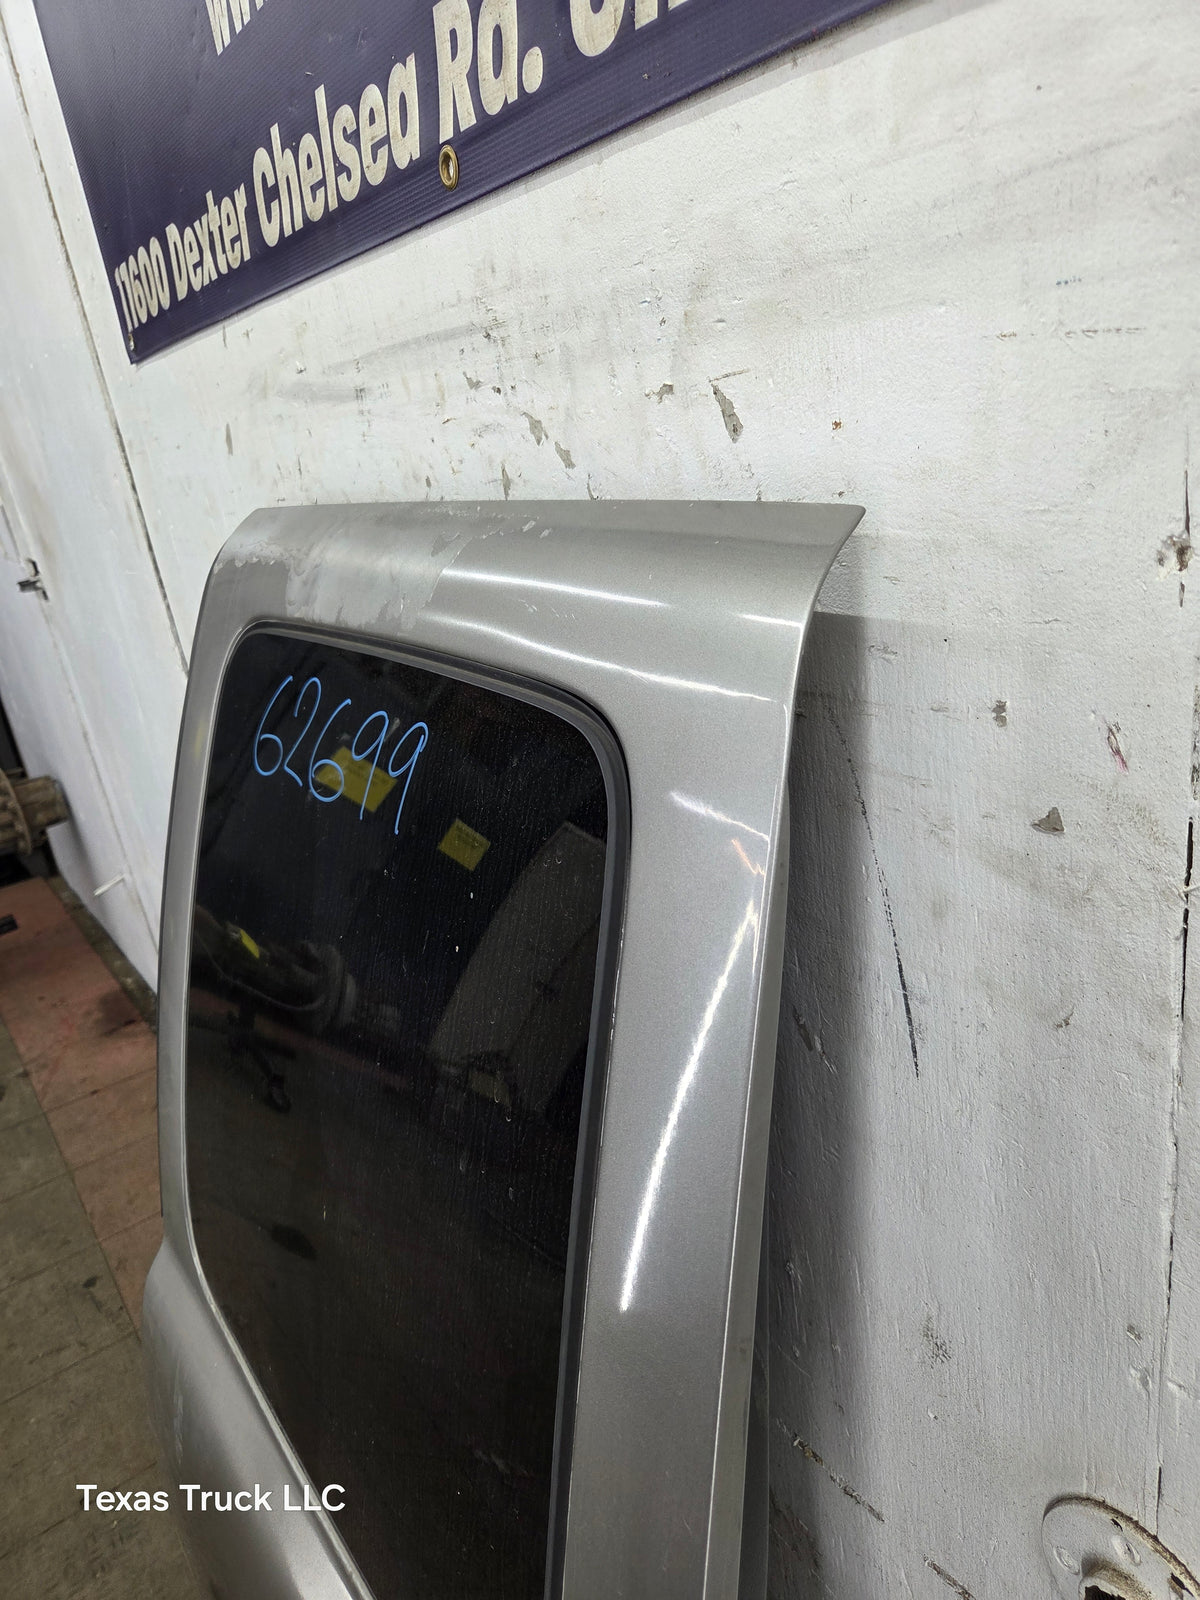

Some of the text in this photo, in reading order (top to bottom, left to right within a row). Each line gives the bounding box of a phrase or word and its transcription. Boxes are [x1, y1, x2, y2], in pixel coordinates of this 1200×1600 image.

[115, 236, 170, 333] 11600
[165, 182, 251, 302] Dexter
[252, 53, 420, 248] Chelsea
[254, 675, 429, 834] 62699
